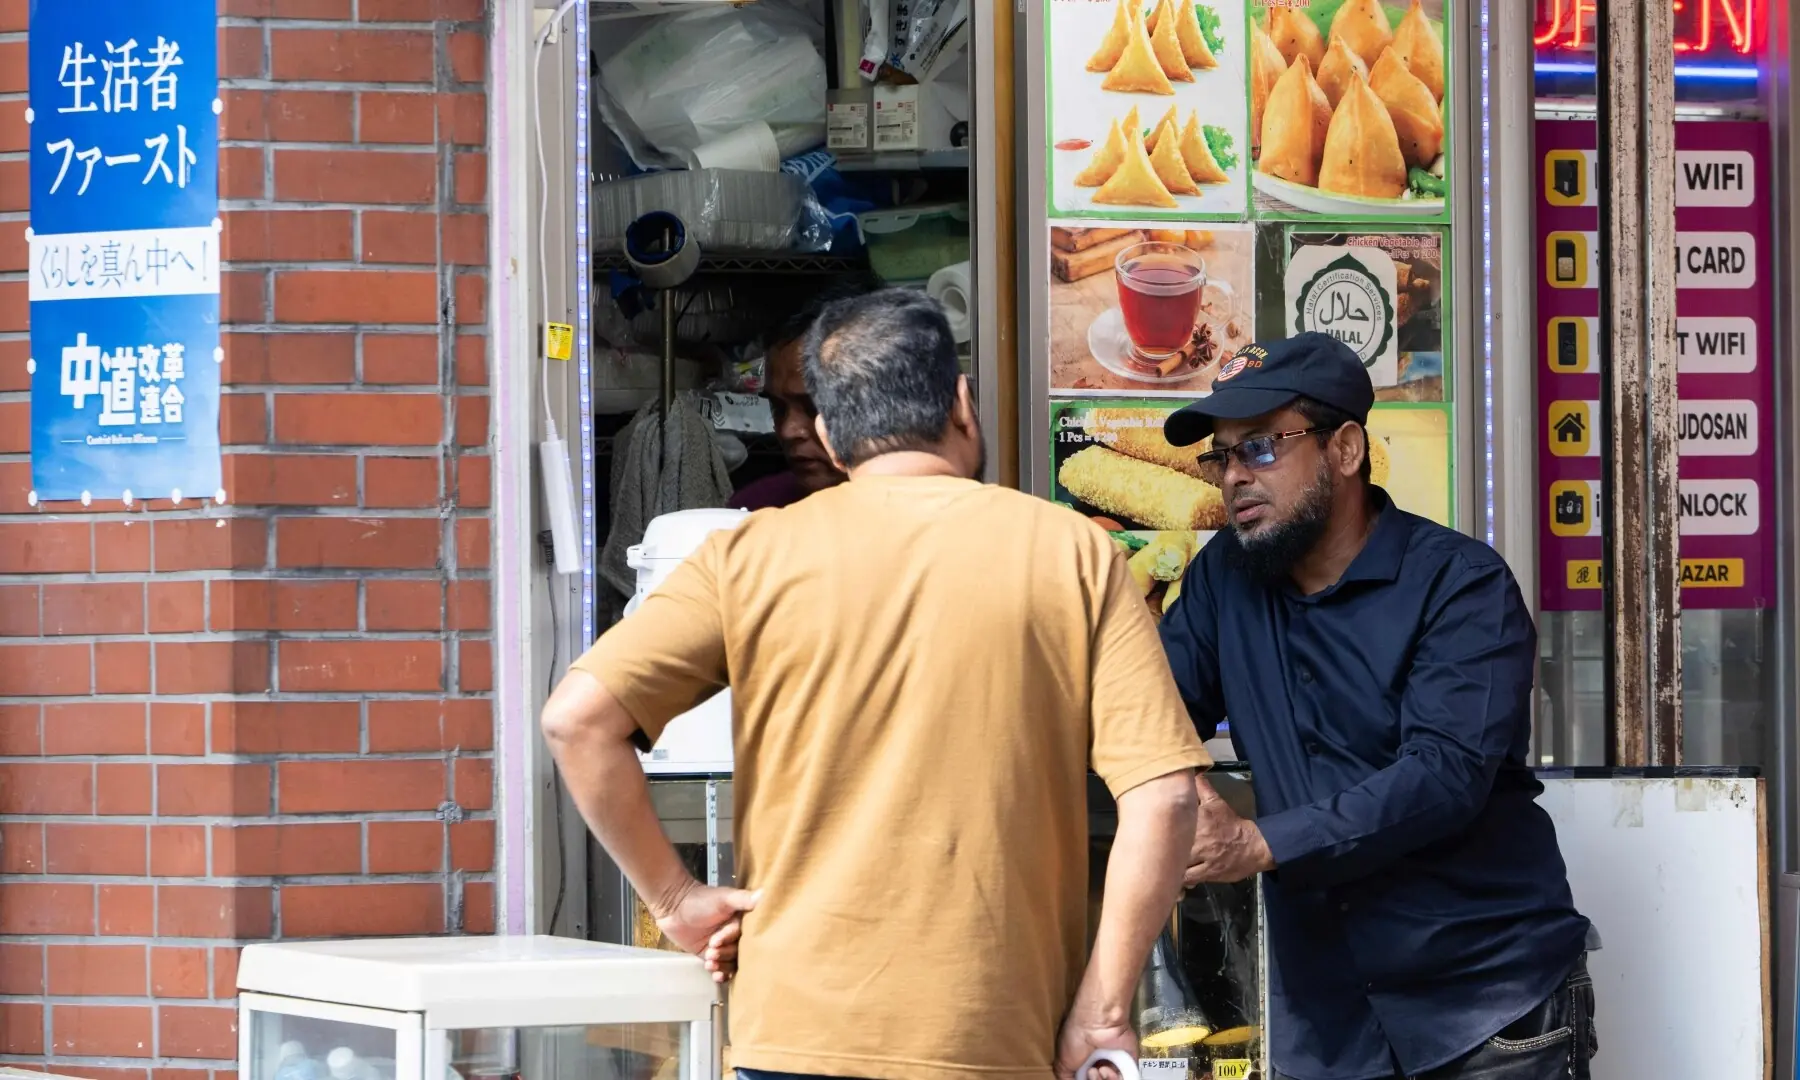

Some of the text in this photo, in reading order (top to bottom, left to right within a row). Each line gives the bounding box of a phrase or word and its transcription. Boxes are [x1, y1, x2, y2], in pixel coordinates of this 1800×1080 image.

[57, 36, 184, 113] 生活者
[47, 124, 197, 196] ファースト
[1683, 163, 1743, 191] WIFI
[1347, 236, 1379, 247] Chicken
[1421, 236, 1437, 247] Roll
[40, 237, 208, 288] くらしを真ん中へ！
[1687, 246, 1745, 274] CARD
[1306, 272, 1382, 322] Halal Certification Services
[1319, 290, 1370, 326] حلال
[1695, 332, 1746, 355] WIFI
[60, 333, 185, 426] 中道 改革
[1060, 432, 1065, 442] 1
[1067, 432, 1083, 442] Pcs
[1678, 412, 1747, 440] UDOSAN
[1680, 493, 1747, 517] NLOCK
[1681, 565, 1729, 582] AZAR
[1218, 1065, 1237, 1077] 100
